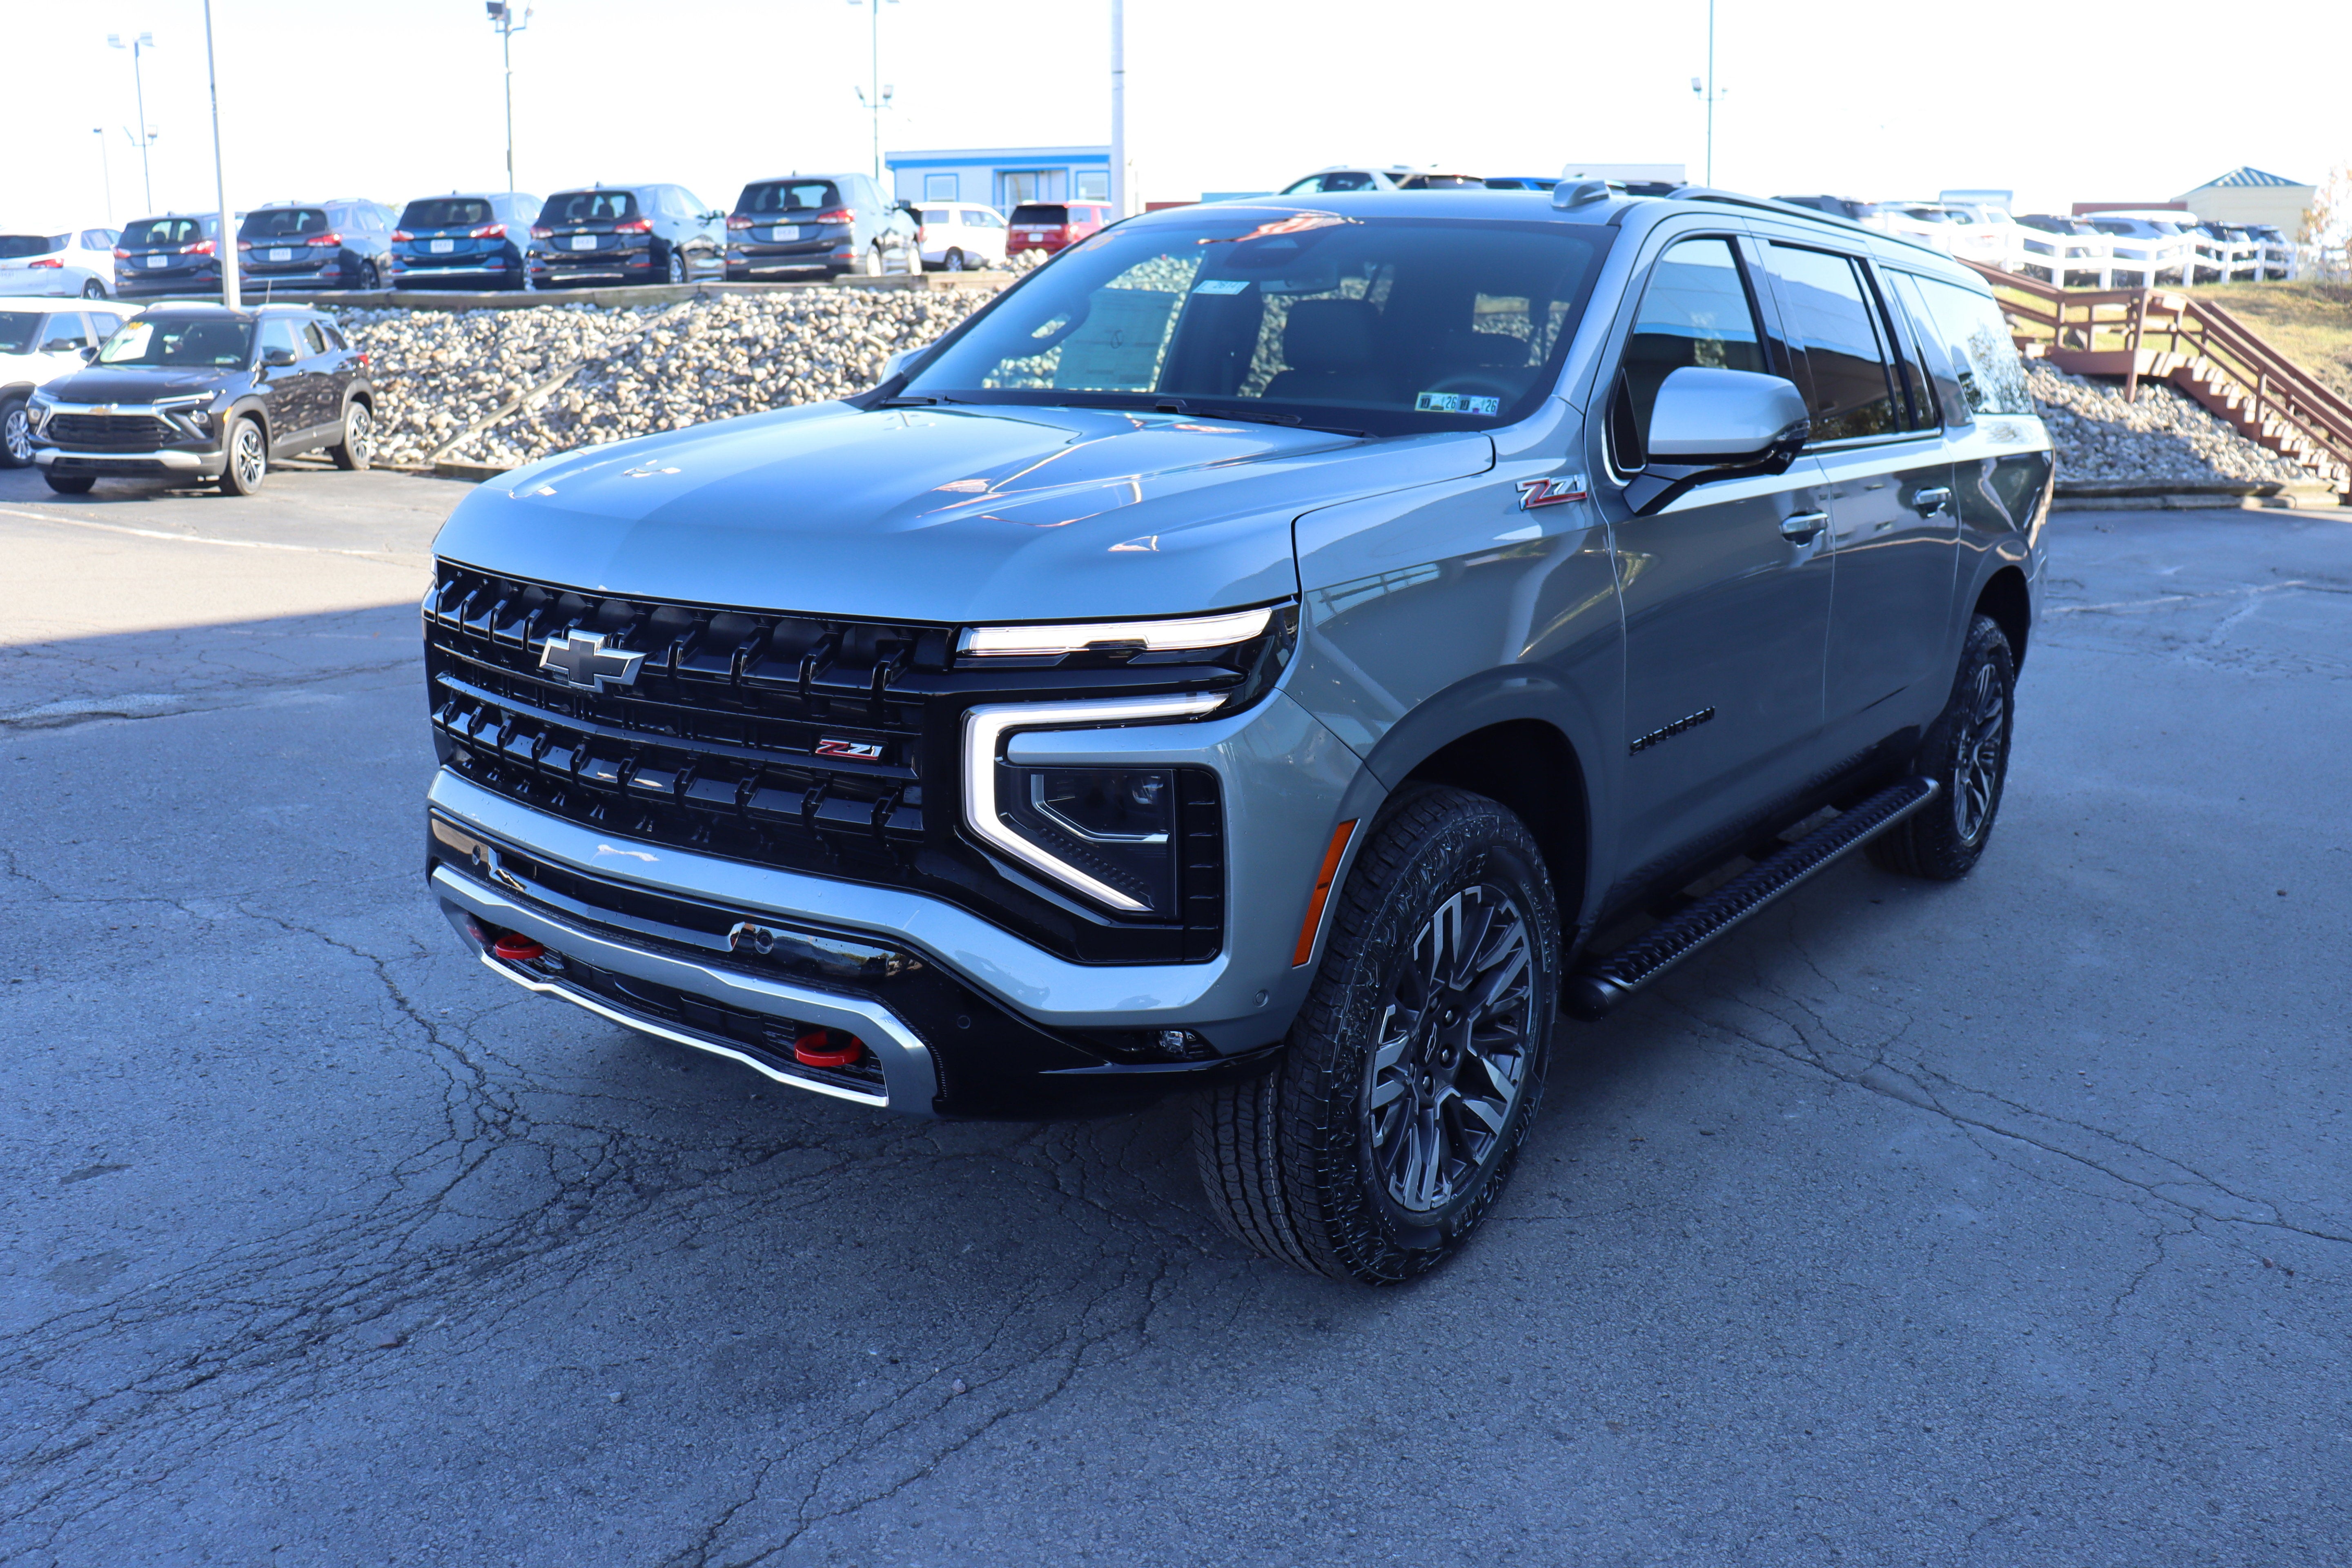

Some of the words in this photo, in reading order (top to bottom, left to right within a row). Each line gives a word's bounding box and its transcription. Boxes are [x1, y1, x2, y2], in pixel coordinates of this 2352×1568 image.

[1421, 398, 1430, 408] 10
[1446, 396, 1457, 409] 26
[1460, 399, 1470, 411] 10
[1486, 399, 1497, 412] 26
[1515, 474, 1587, 510] Z71
[1630, 706, 1715, 756] SUBURBAN
[815, 739, 883, 760] Z71
